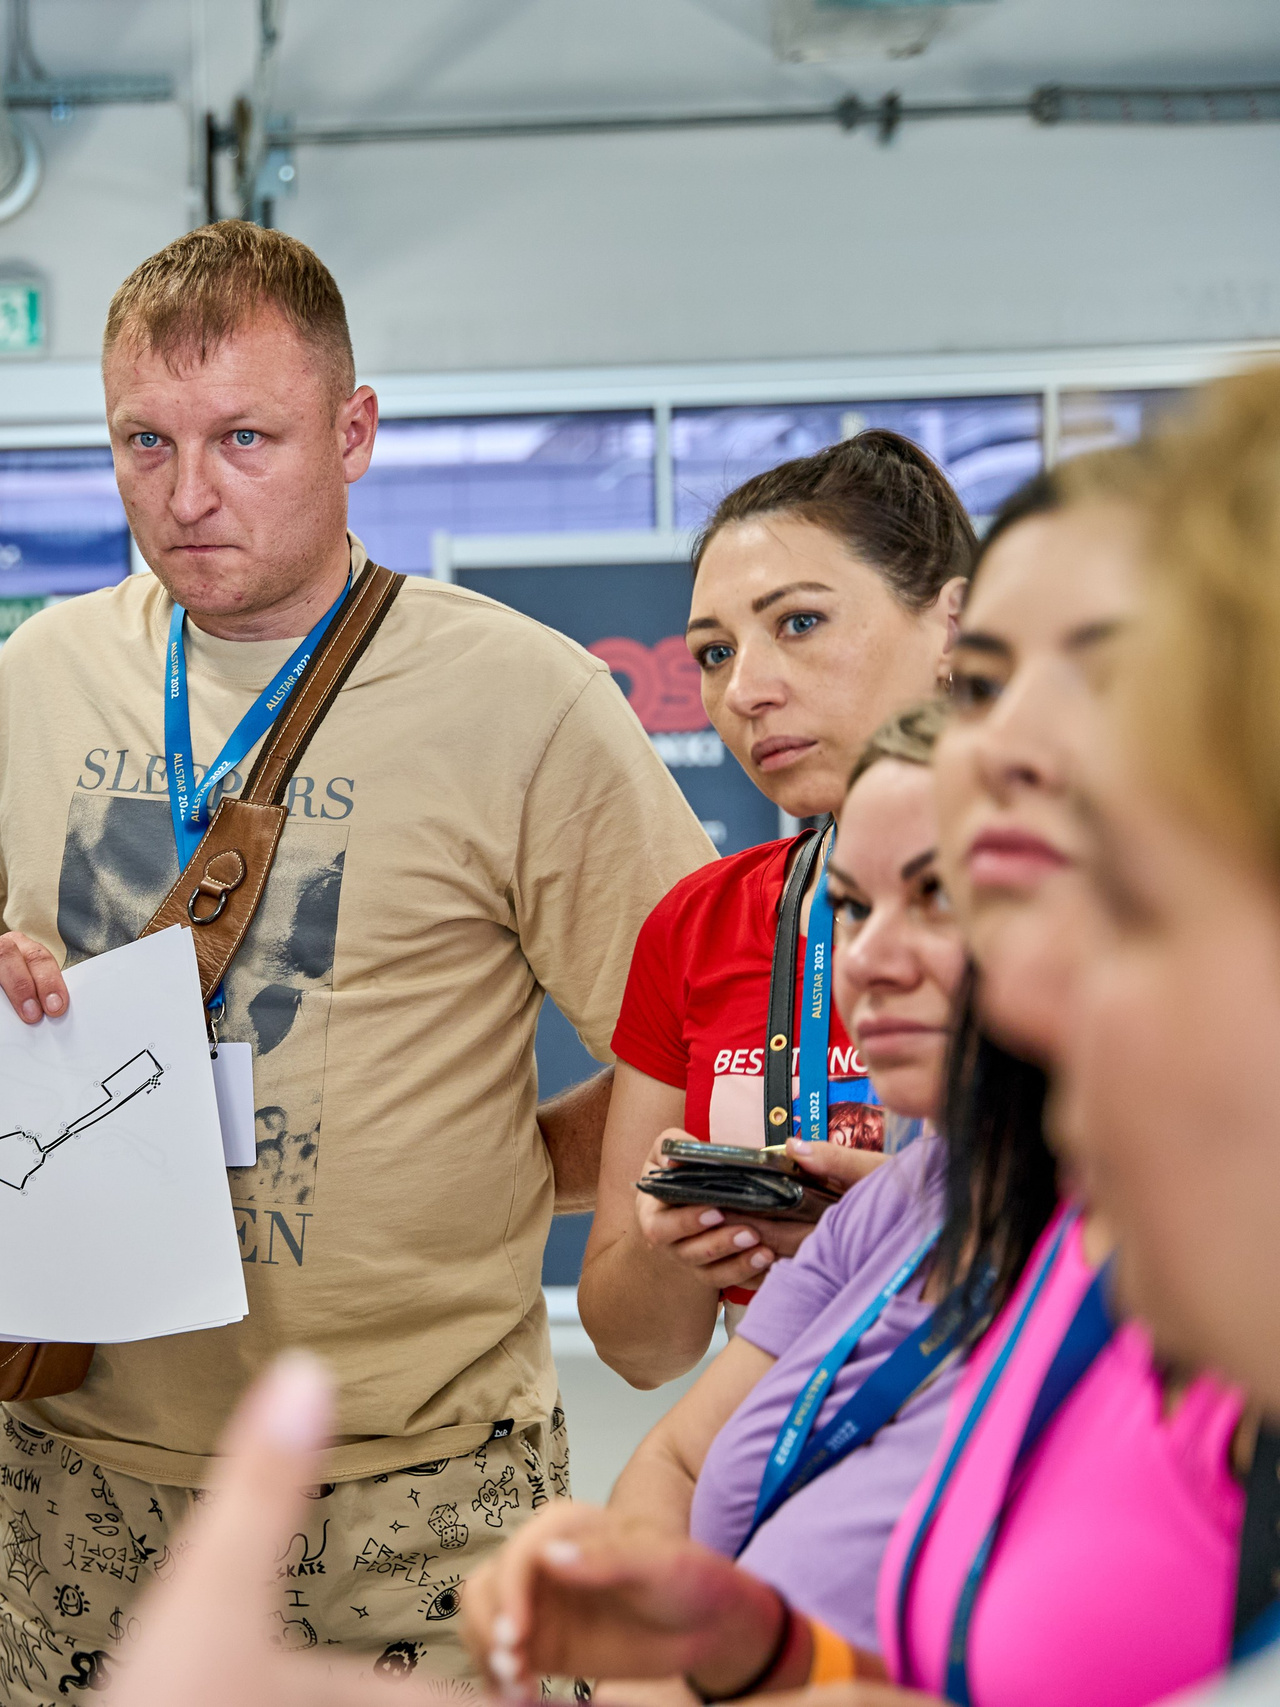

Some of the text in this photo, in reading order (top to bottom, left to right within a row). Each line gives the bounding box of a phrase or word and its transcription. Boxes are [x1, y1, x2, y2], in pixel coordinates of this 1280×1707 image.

[171, 641, 179, 700] ALLSTAR 2022
[265, 675, 297, 712] ALLSTAR
[76, 748, 355, 822] SLEPRS
[173, 753, 187, 794] ALLSTAR
[190, 760, 231, 822] ALLSTAR 2022
[812, 942, 825, 1019] ALLSTAR 2022
[714, 1048, 764, 1074] BES
[809, 1091, 820, 1121] 2022
[41, 1440, 54, 1455] UP
[62, 1551, 139, 1584] CRAZY
[276, 1560, 326, 1579] SKATE
[362, 1537, 439, 1570] CRAZY
[353, 1555, 431, 1587] PEOPLE
